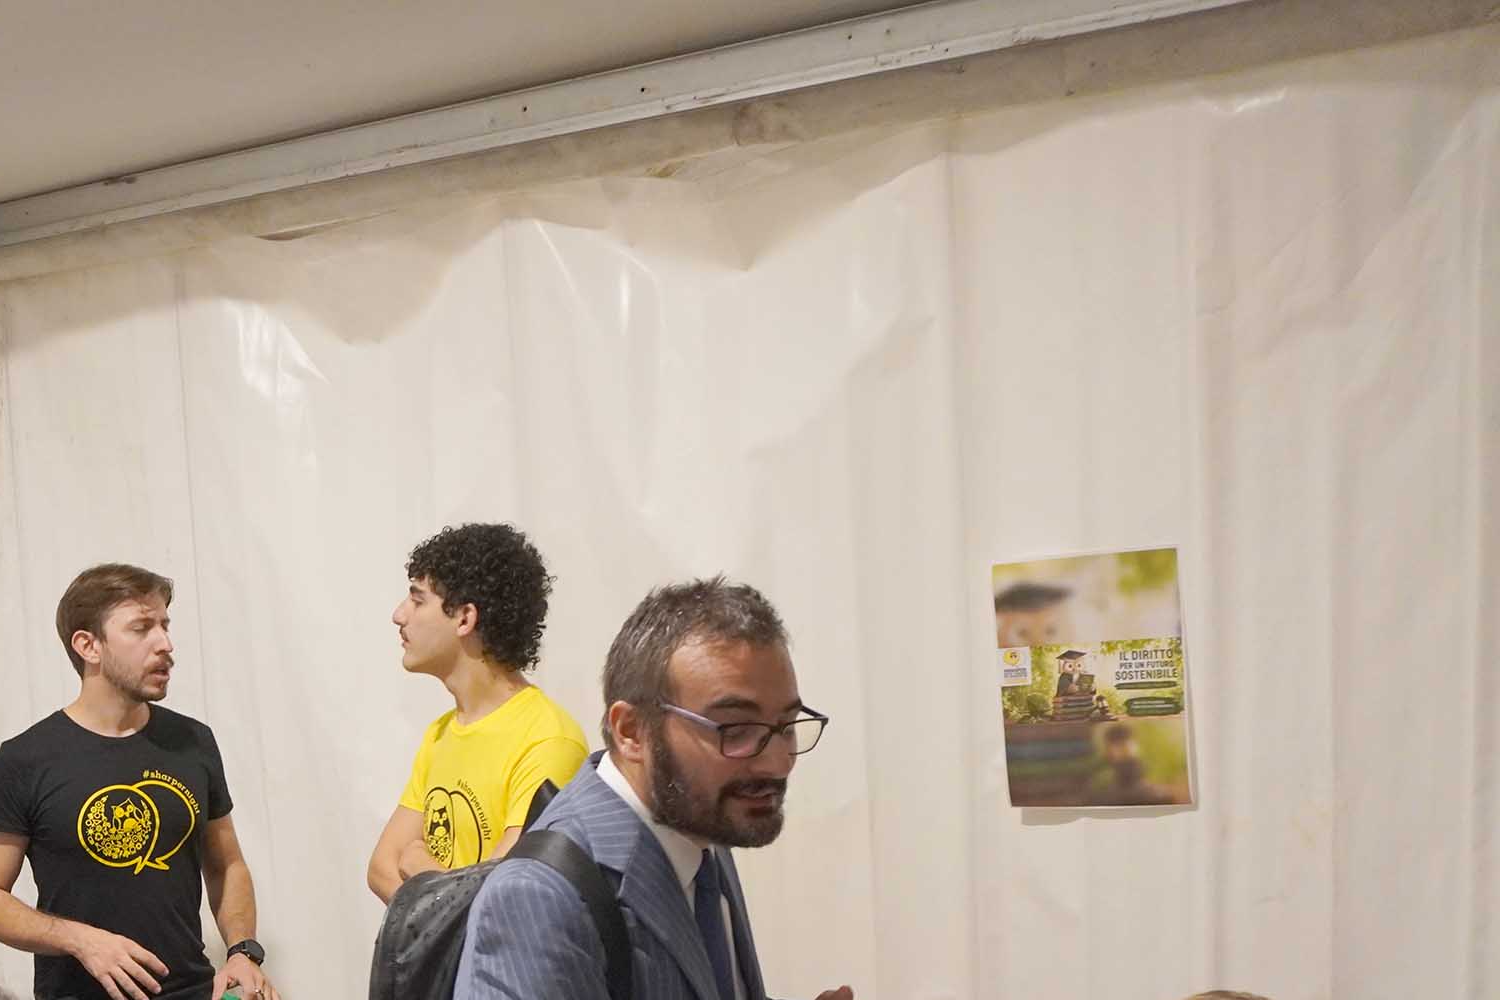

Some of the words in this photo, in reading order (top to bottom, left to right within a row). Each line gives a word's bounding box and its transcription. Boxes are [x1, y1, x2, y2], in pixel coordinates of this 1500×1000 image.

[1119, 651, 1129, 661] IL
[1131, 648, 1174, 660] DIRITTO
[1134, 661, 1145, 669] UN
[1115, 668, 1179, 680] SOSTENIBILE
[143, 769, 200, 815] #sharpernight
